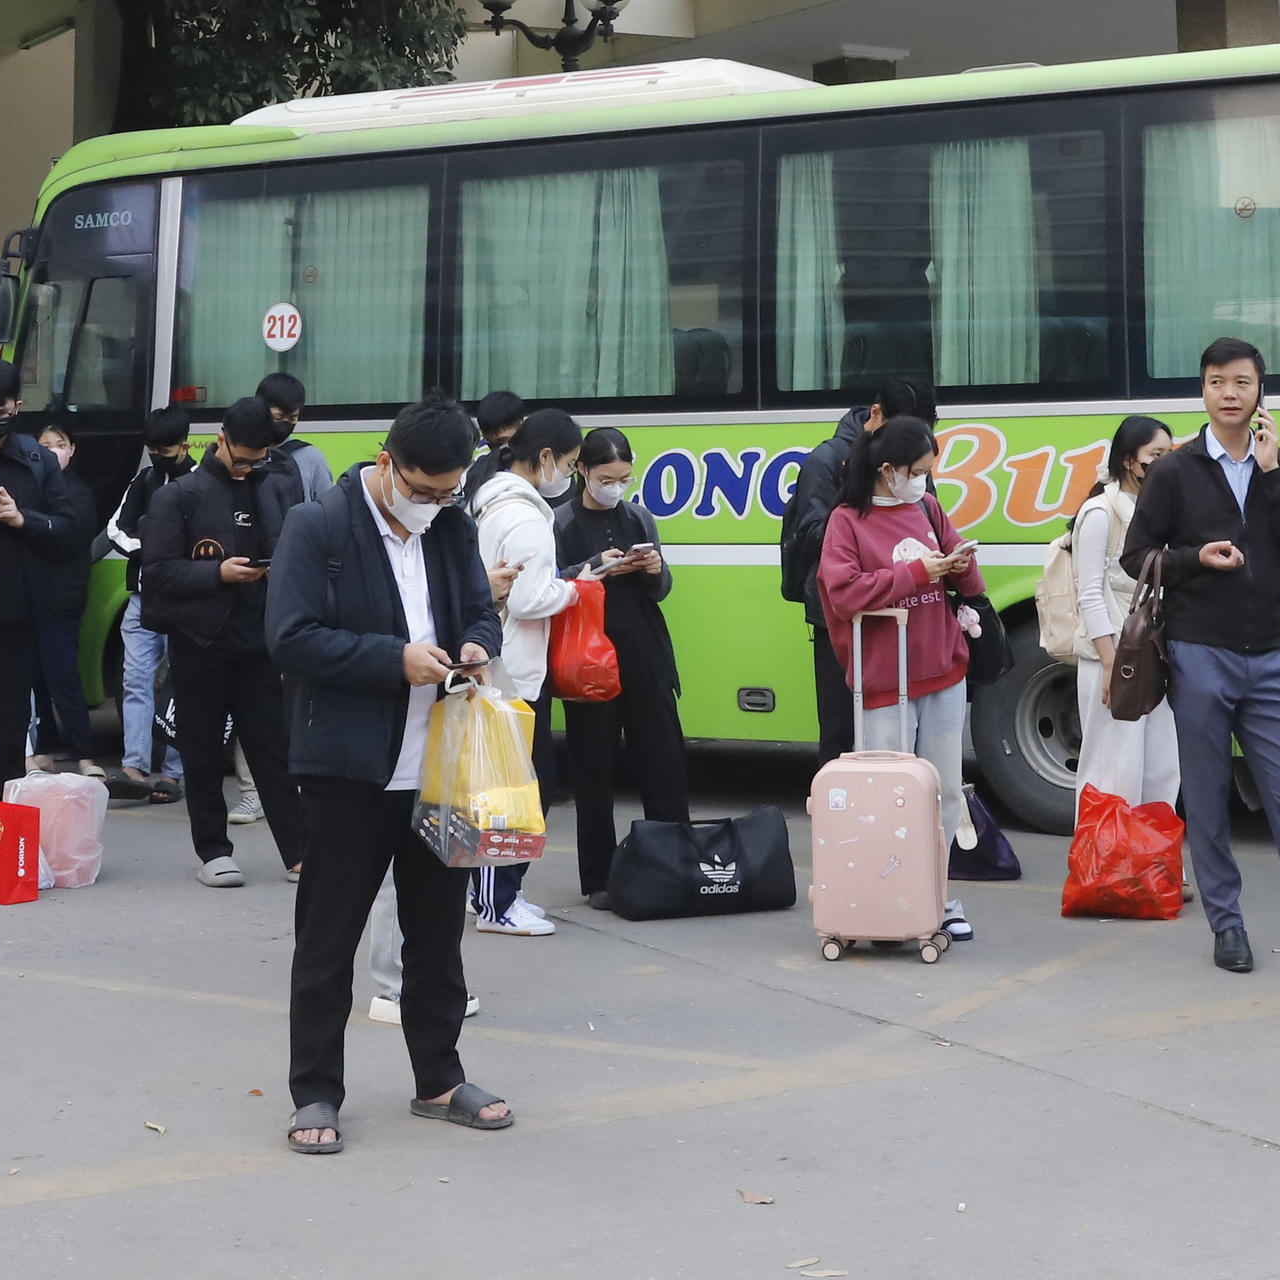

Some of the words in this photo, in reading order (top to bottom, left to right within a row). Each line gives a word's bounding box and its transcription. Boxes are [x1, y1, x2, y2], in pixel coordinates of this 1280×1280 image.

[74, 211, 132, 230] SAMCO
[267, 314, 297, 338] 212
[632, 449, 812, 519] ONG
[921, 589, 942, 604] est
[700, 883, 740, 894] adidas
